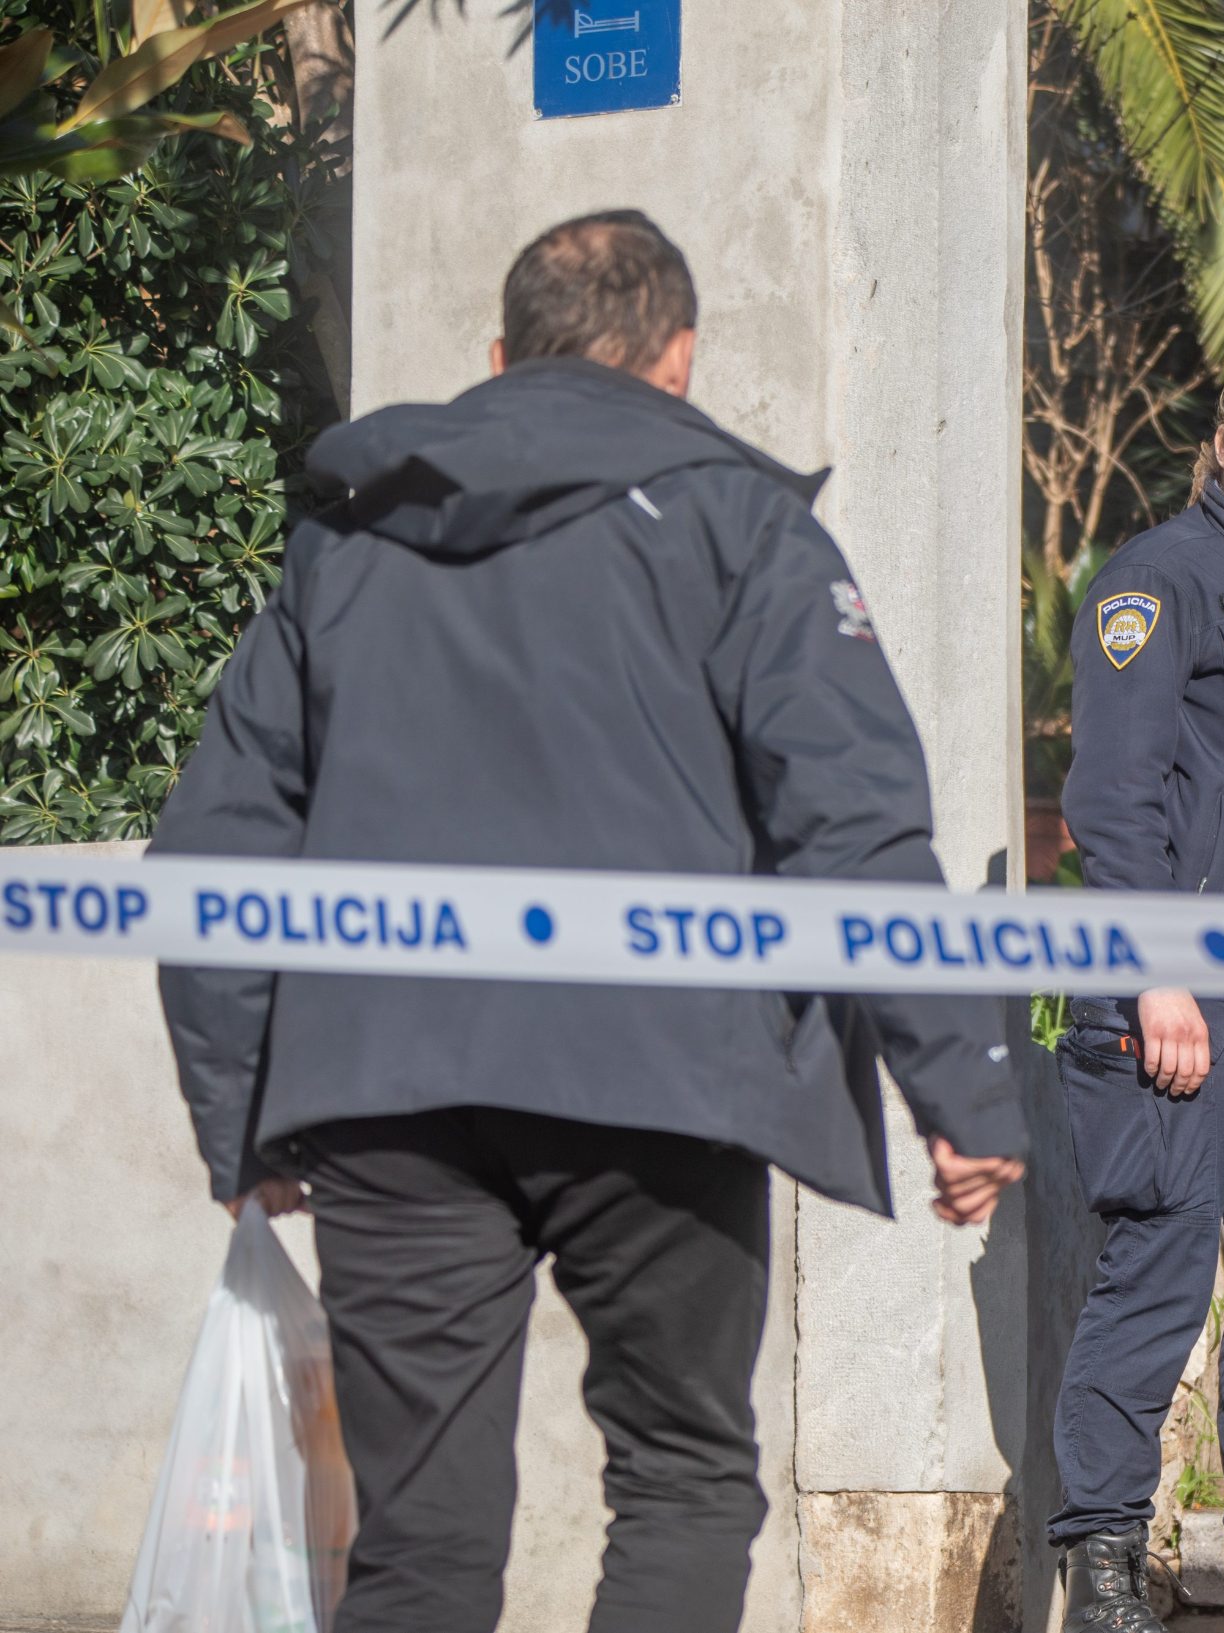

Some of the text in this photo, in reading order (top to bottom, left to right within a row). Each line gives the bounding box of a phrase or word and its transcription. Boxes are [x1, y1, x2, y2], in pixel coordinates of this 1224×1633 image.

[565, 49, 648, 84] SOBE
[1103, 597, 1156, 615] POLICIJA
[1, 879, 149, 935] STOP
[194, 889, 468, 951] POLICIJA
[624, 905, 788, 960] STOP
[837, 913, 1149, 974] POLICIJA
